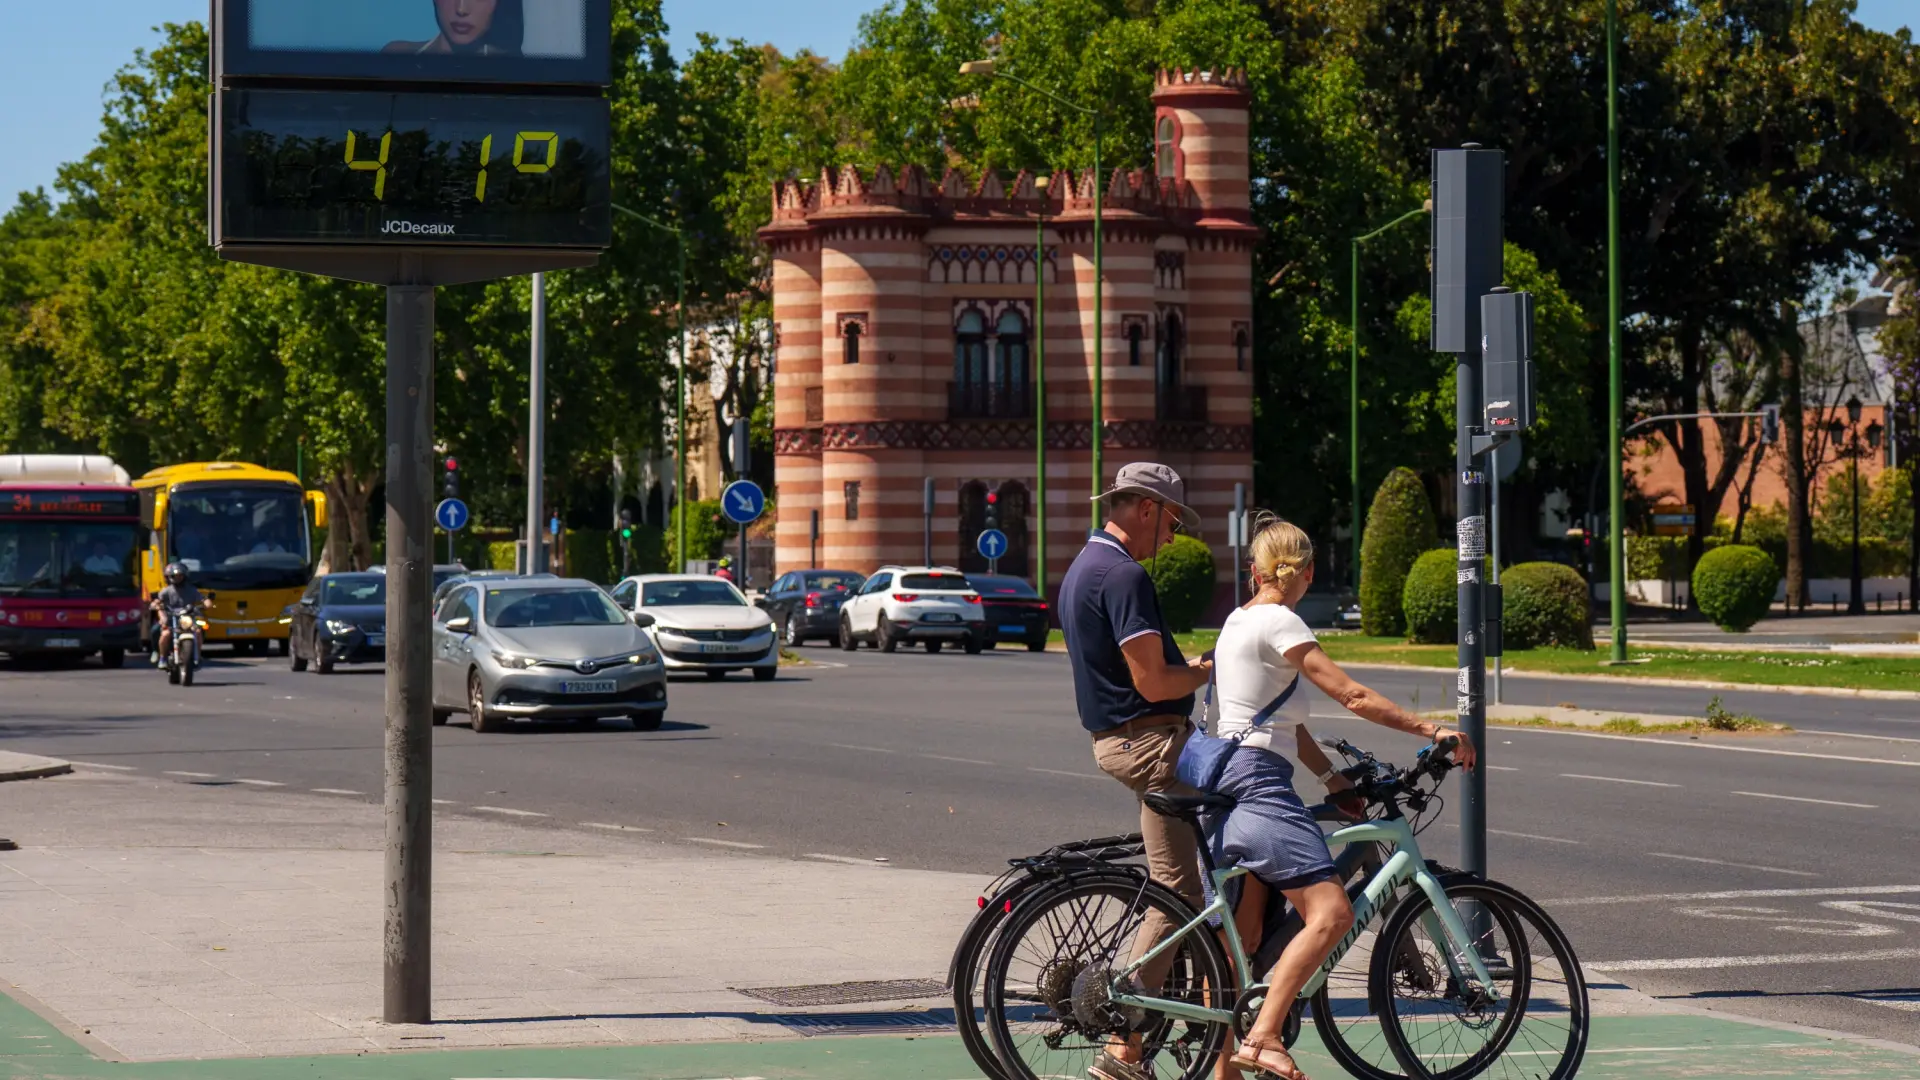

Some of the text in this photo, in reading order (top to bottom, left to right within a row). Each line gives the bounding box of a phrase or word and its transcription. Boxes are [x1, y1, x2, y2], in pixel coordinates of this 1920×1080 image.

[381, 220, 455, 234] JCDecaux
[13, 494, 32, 512] 34
[567, 682, 593, 692] 7920
